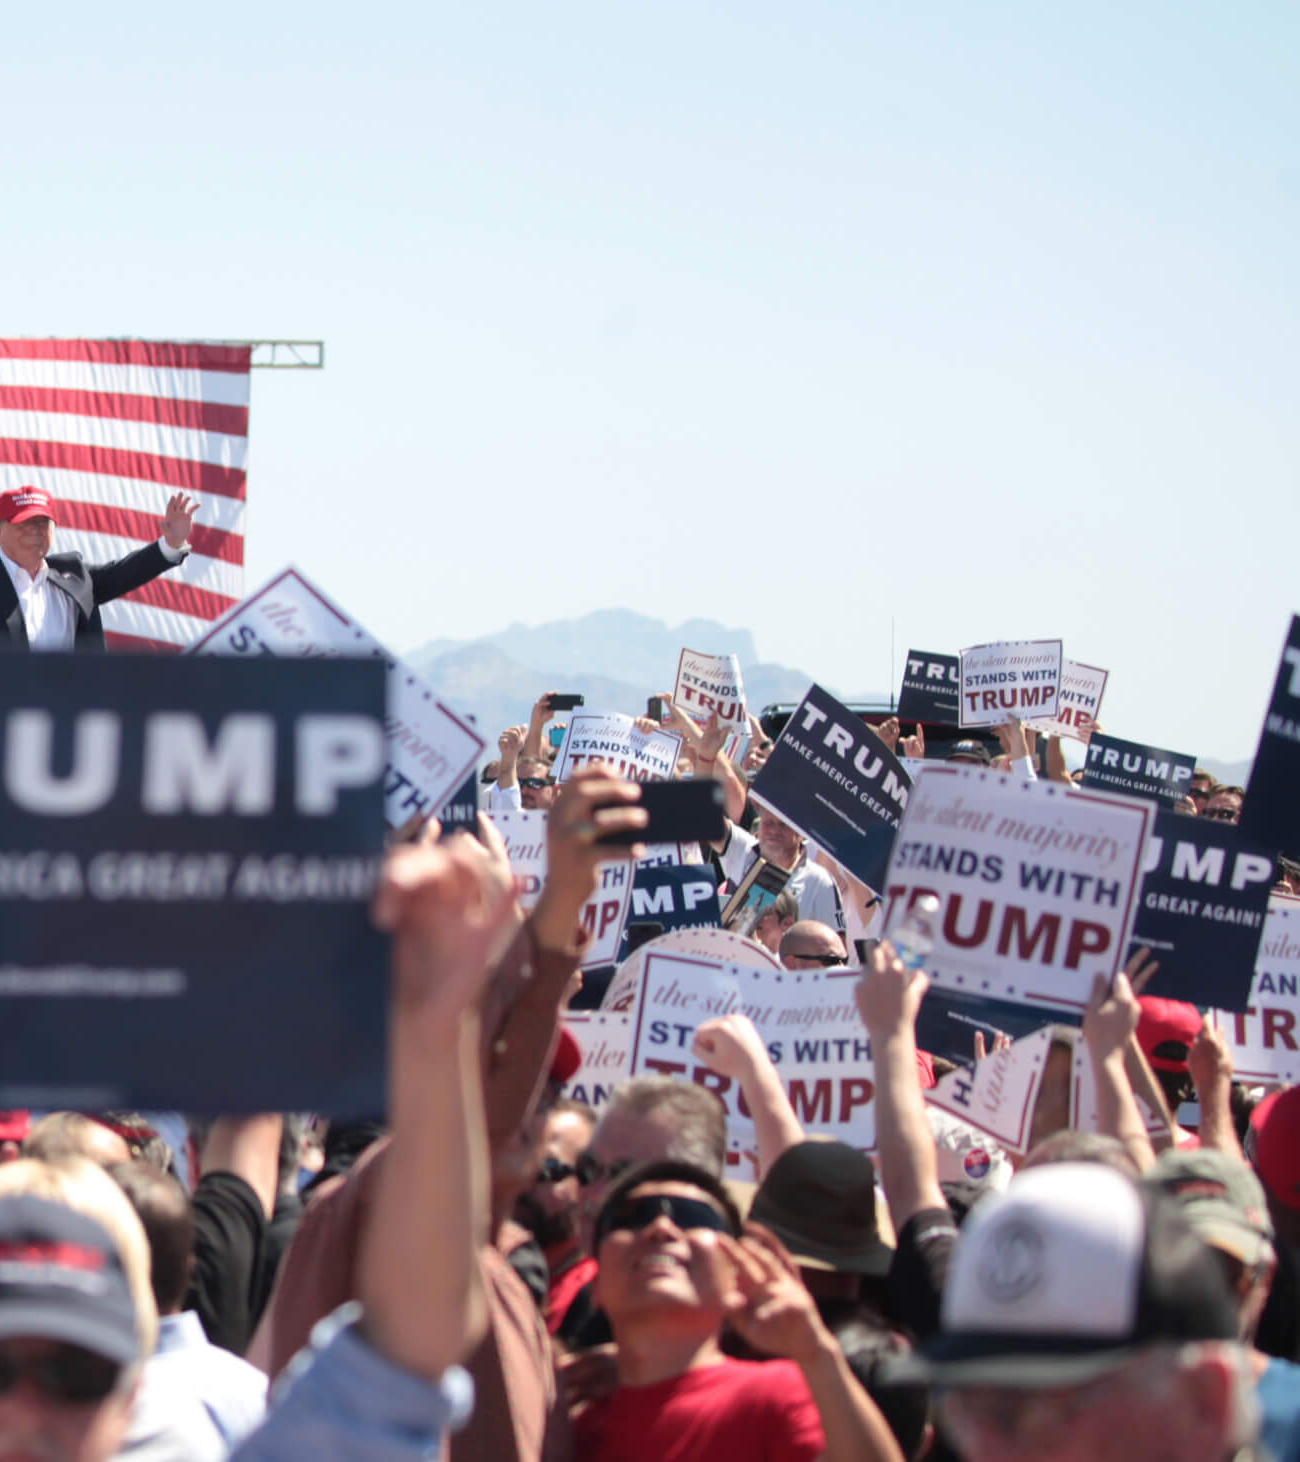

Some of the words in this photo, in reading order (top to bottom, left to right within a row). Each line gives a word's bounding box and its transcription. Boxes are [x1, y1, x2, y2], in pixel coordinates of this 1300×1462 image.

[683, 672, 738, 697] STANDS
[908, 659, 959, 683] TRU
[965, 671, 1017, 688] STANDS
[1022, 669, 1058, 682] WITH
[681, 684, 746, 723] TRU
[964, 686, 1056, 713] TRUMP
[571, 739, 630, 755] STANDS
[634, 749, 670, 772] WITH
[801, 701, 910, 810] TRUM
[1089, 743, 1192, 783] TRUMP
[783, 732, 814, 760] MAKE
[812, 752, 860, 798] AMERICA
[859, 791, 894, 823] GREAT
[994, 812, 1130, 866] majority
[896, 841, 1004, 884] STANDS
[1018, 861, 1121, 908] WITH
[1146, 892, 1200, 916] GREAT
[1201, 903, 1262, 929] AGAIN!
[652, 979, 700, 1009] the
[794, 1038, 873, 1064] WITH
